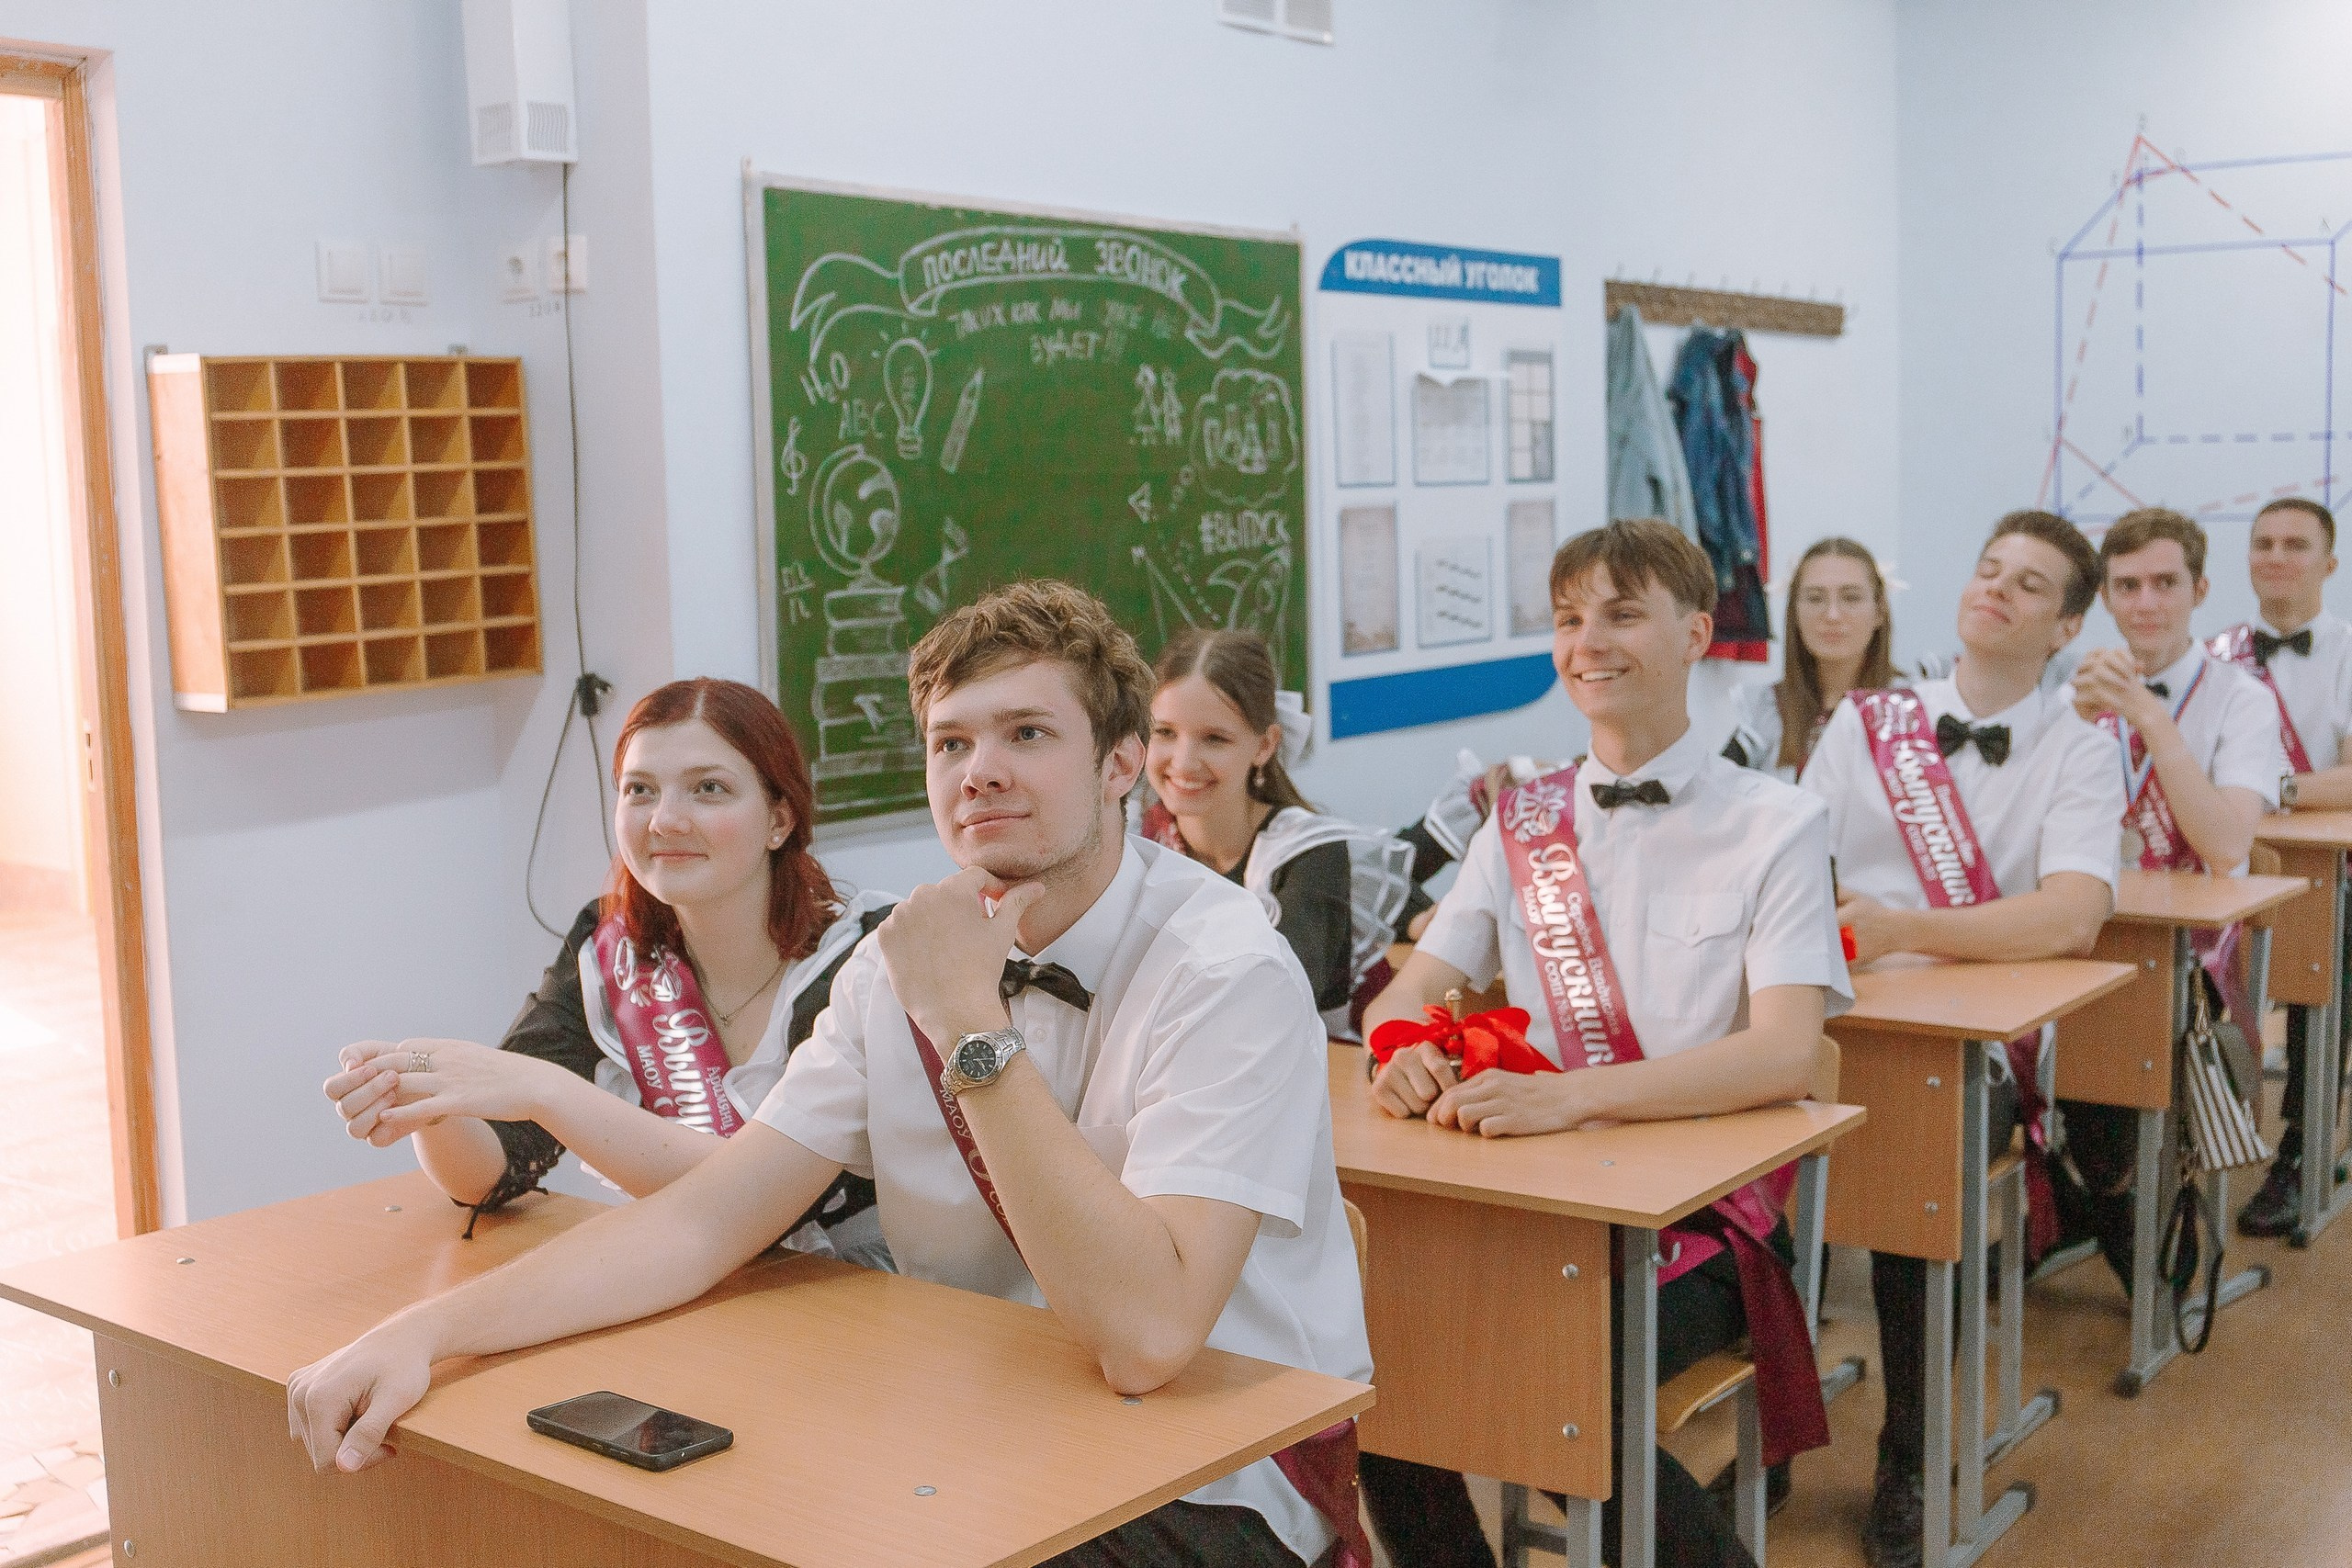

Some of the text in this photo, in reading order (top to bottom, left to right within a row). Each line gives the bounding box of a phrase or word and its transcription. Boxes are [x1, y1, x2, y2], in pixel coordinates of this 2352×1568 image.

[922, 237, 1070, 289] ПОСЛЕДНИЙ
[1343, 250, 1540, 294] КЛАССНЫЙ УГОЛОК
[1527, 842, 1615, 1067] Выпускник
[1544, 960, 1566, 998] СОШ
[636, 1044, 665, 1090] МАОУ
